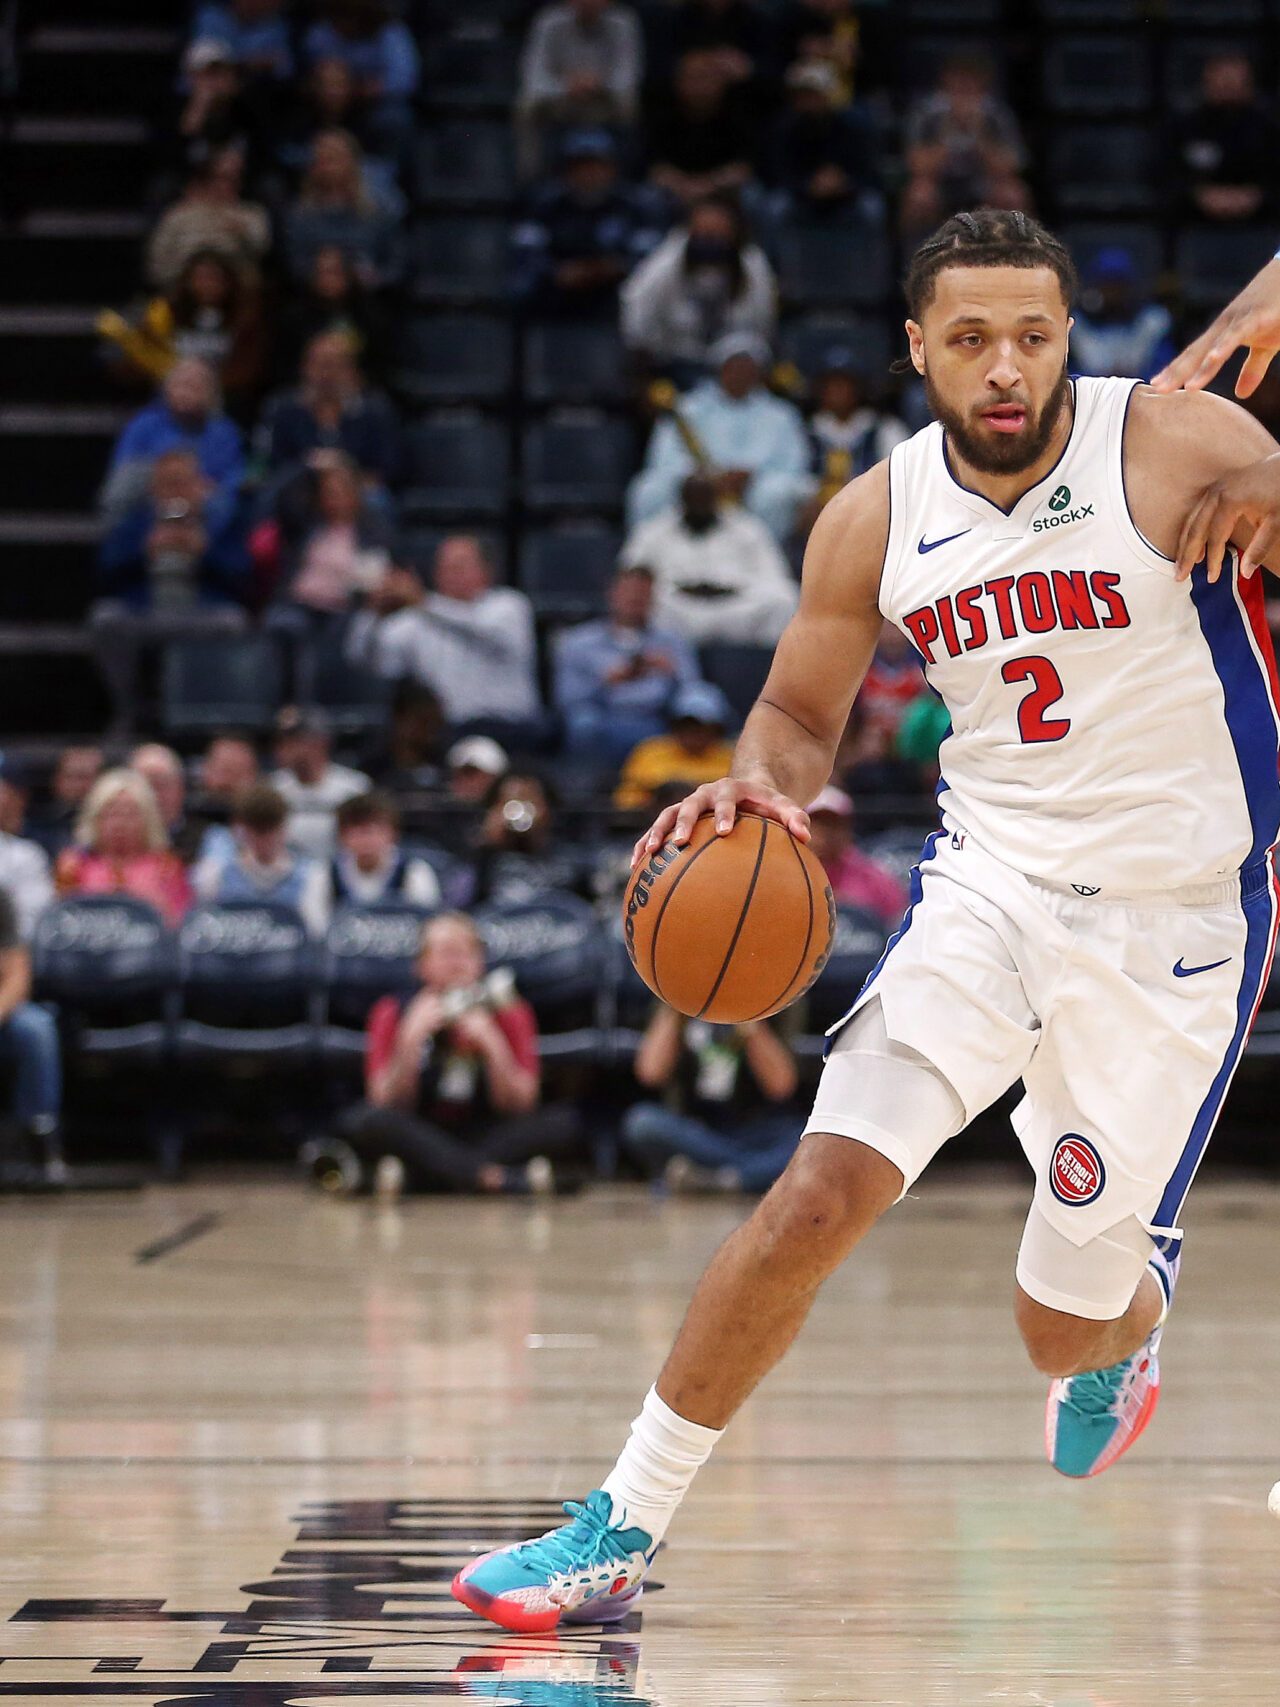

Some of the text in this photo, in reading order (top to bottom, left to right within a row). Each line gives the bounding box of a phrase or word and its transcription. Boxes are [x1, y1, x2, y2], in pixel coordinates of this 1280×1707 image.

[1032, 503, 1095, 533] StockX
[902, 570, 1131, 664] PISTONS
[1001, 655, 1071, 743] 2
[1057, 1155, 1089, 1193] PISTONS
[1062, 1147, 1094, 1184] DETROIT
